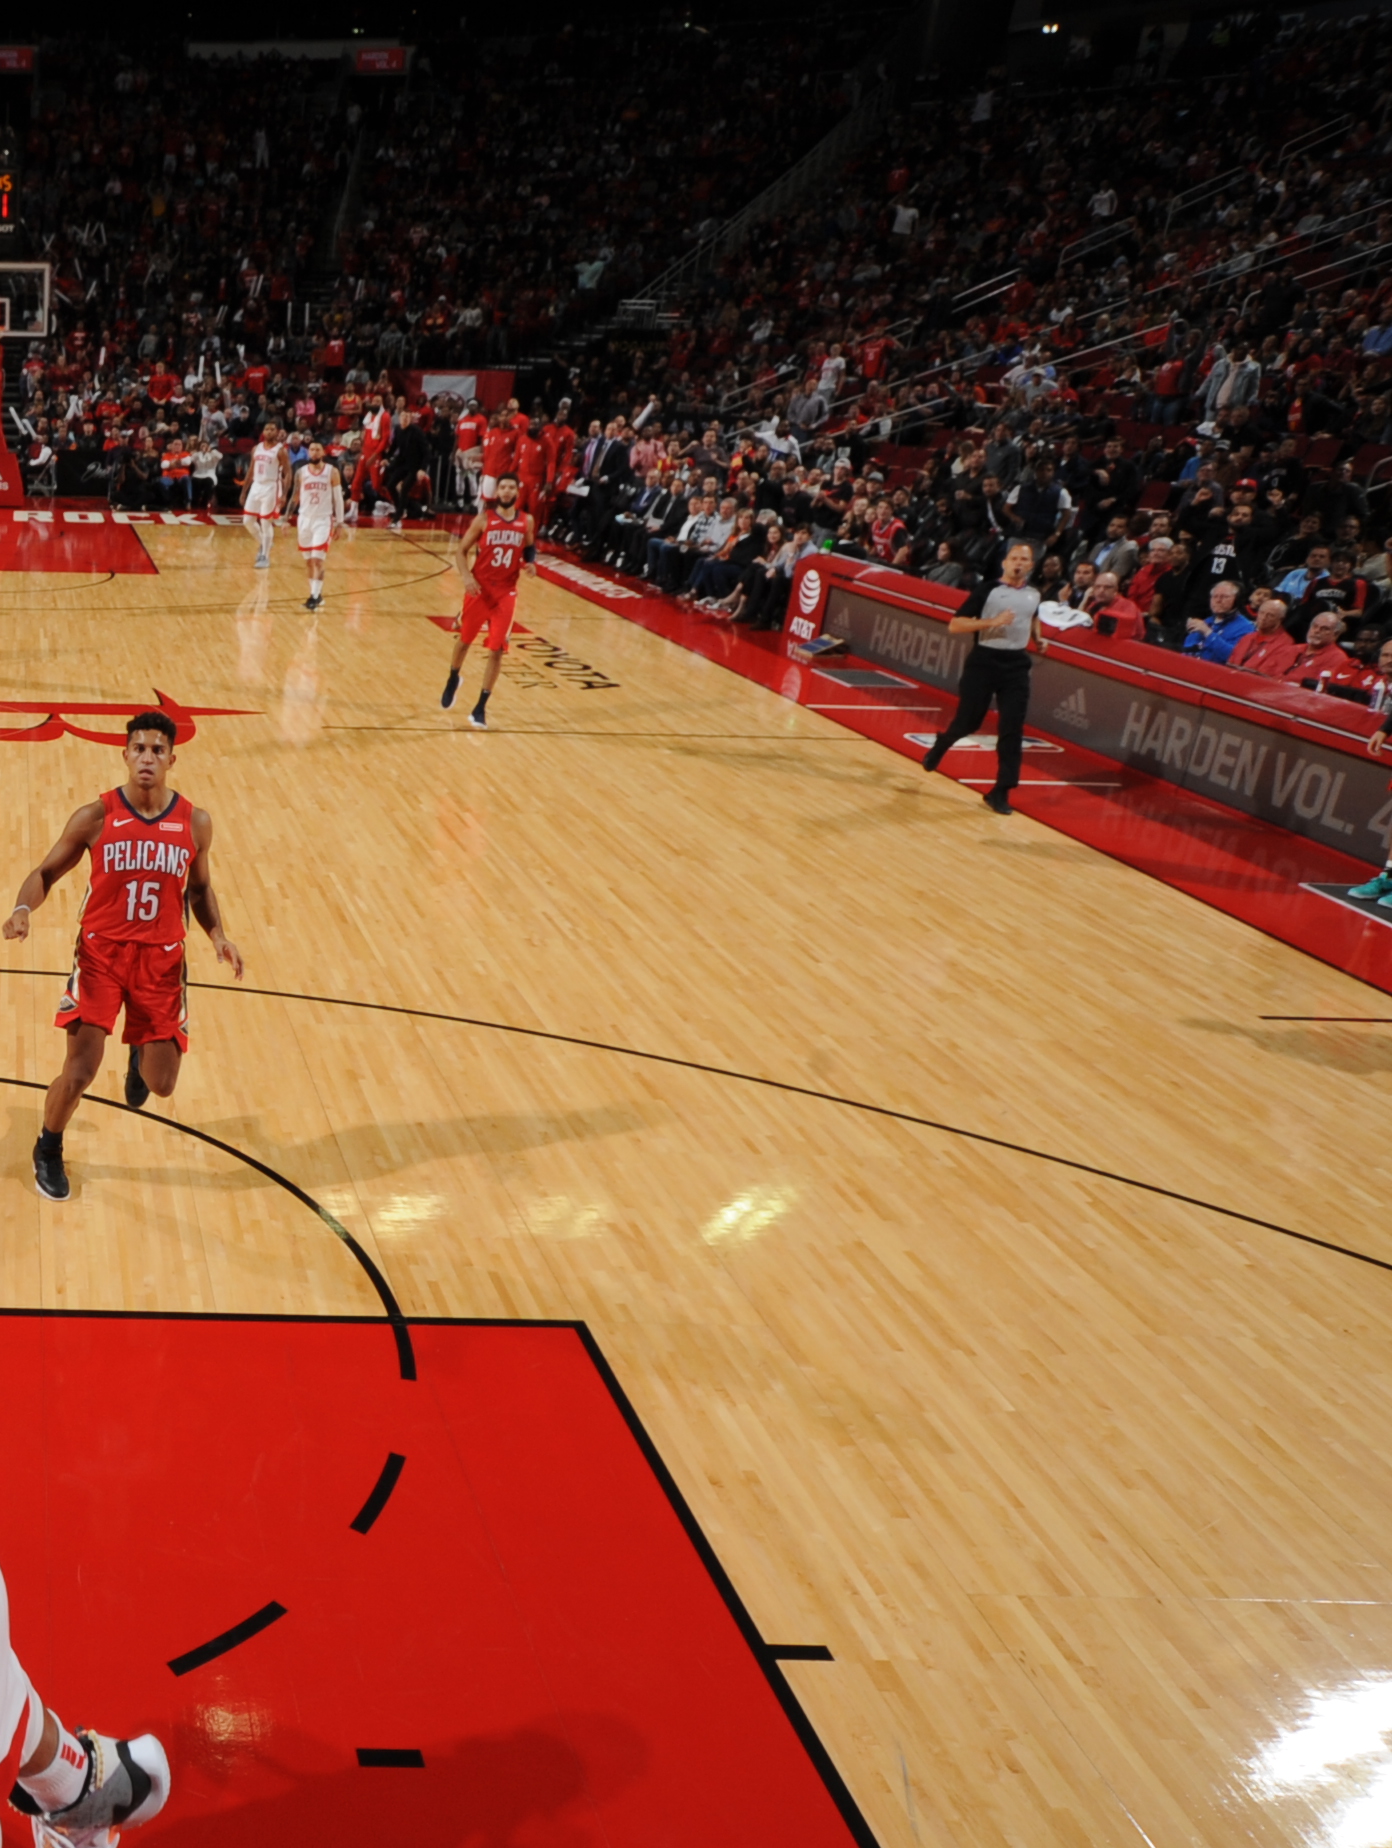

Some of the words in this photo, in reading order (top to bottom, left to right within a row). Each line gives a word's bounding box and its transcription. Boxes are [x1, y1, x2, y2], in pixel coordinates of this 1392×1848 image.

[13, 510, 246, 526] ROCKE
[491, 546, 514, 569] 34
[789, 616, 816, 641] AT&T
[869, 613, 956, 681] HARDEN
[510, 636, 621, 690] TOYOTA
[1120, 701, 1268, 798] HARDEN
[1271, 751, 1355, 836] VOL.
[103, 840, 190, 878] PELICANS
[125, 880, 161, 921] 15
